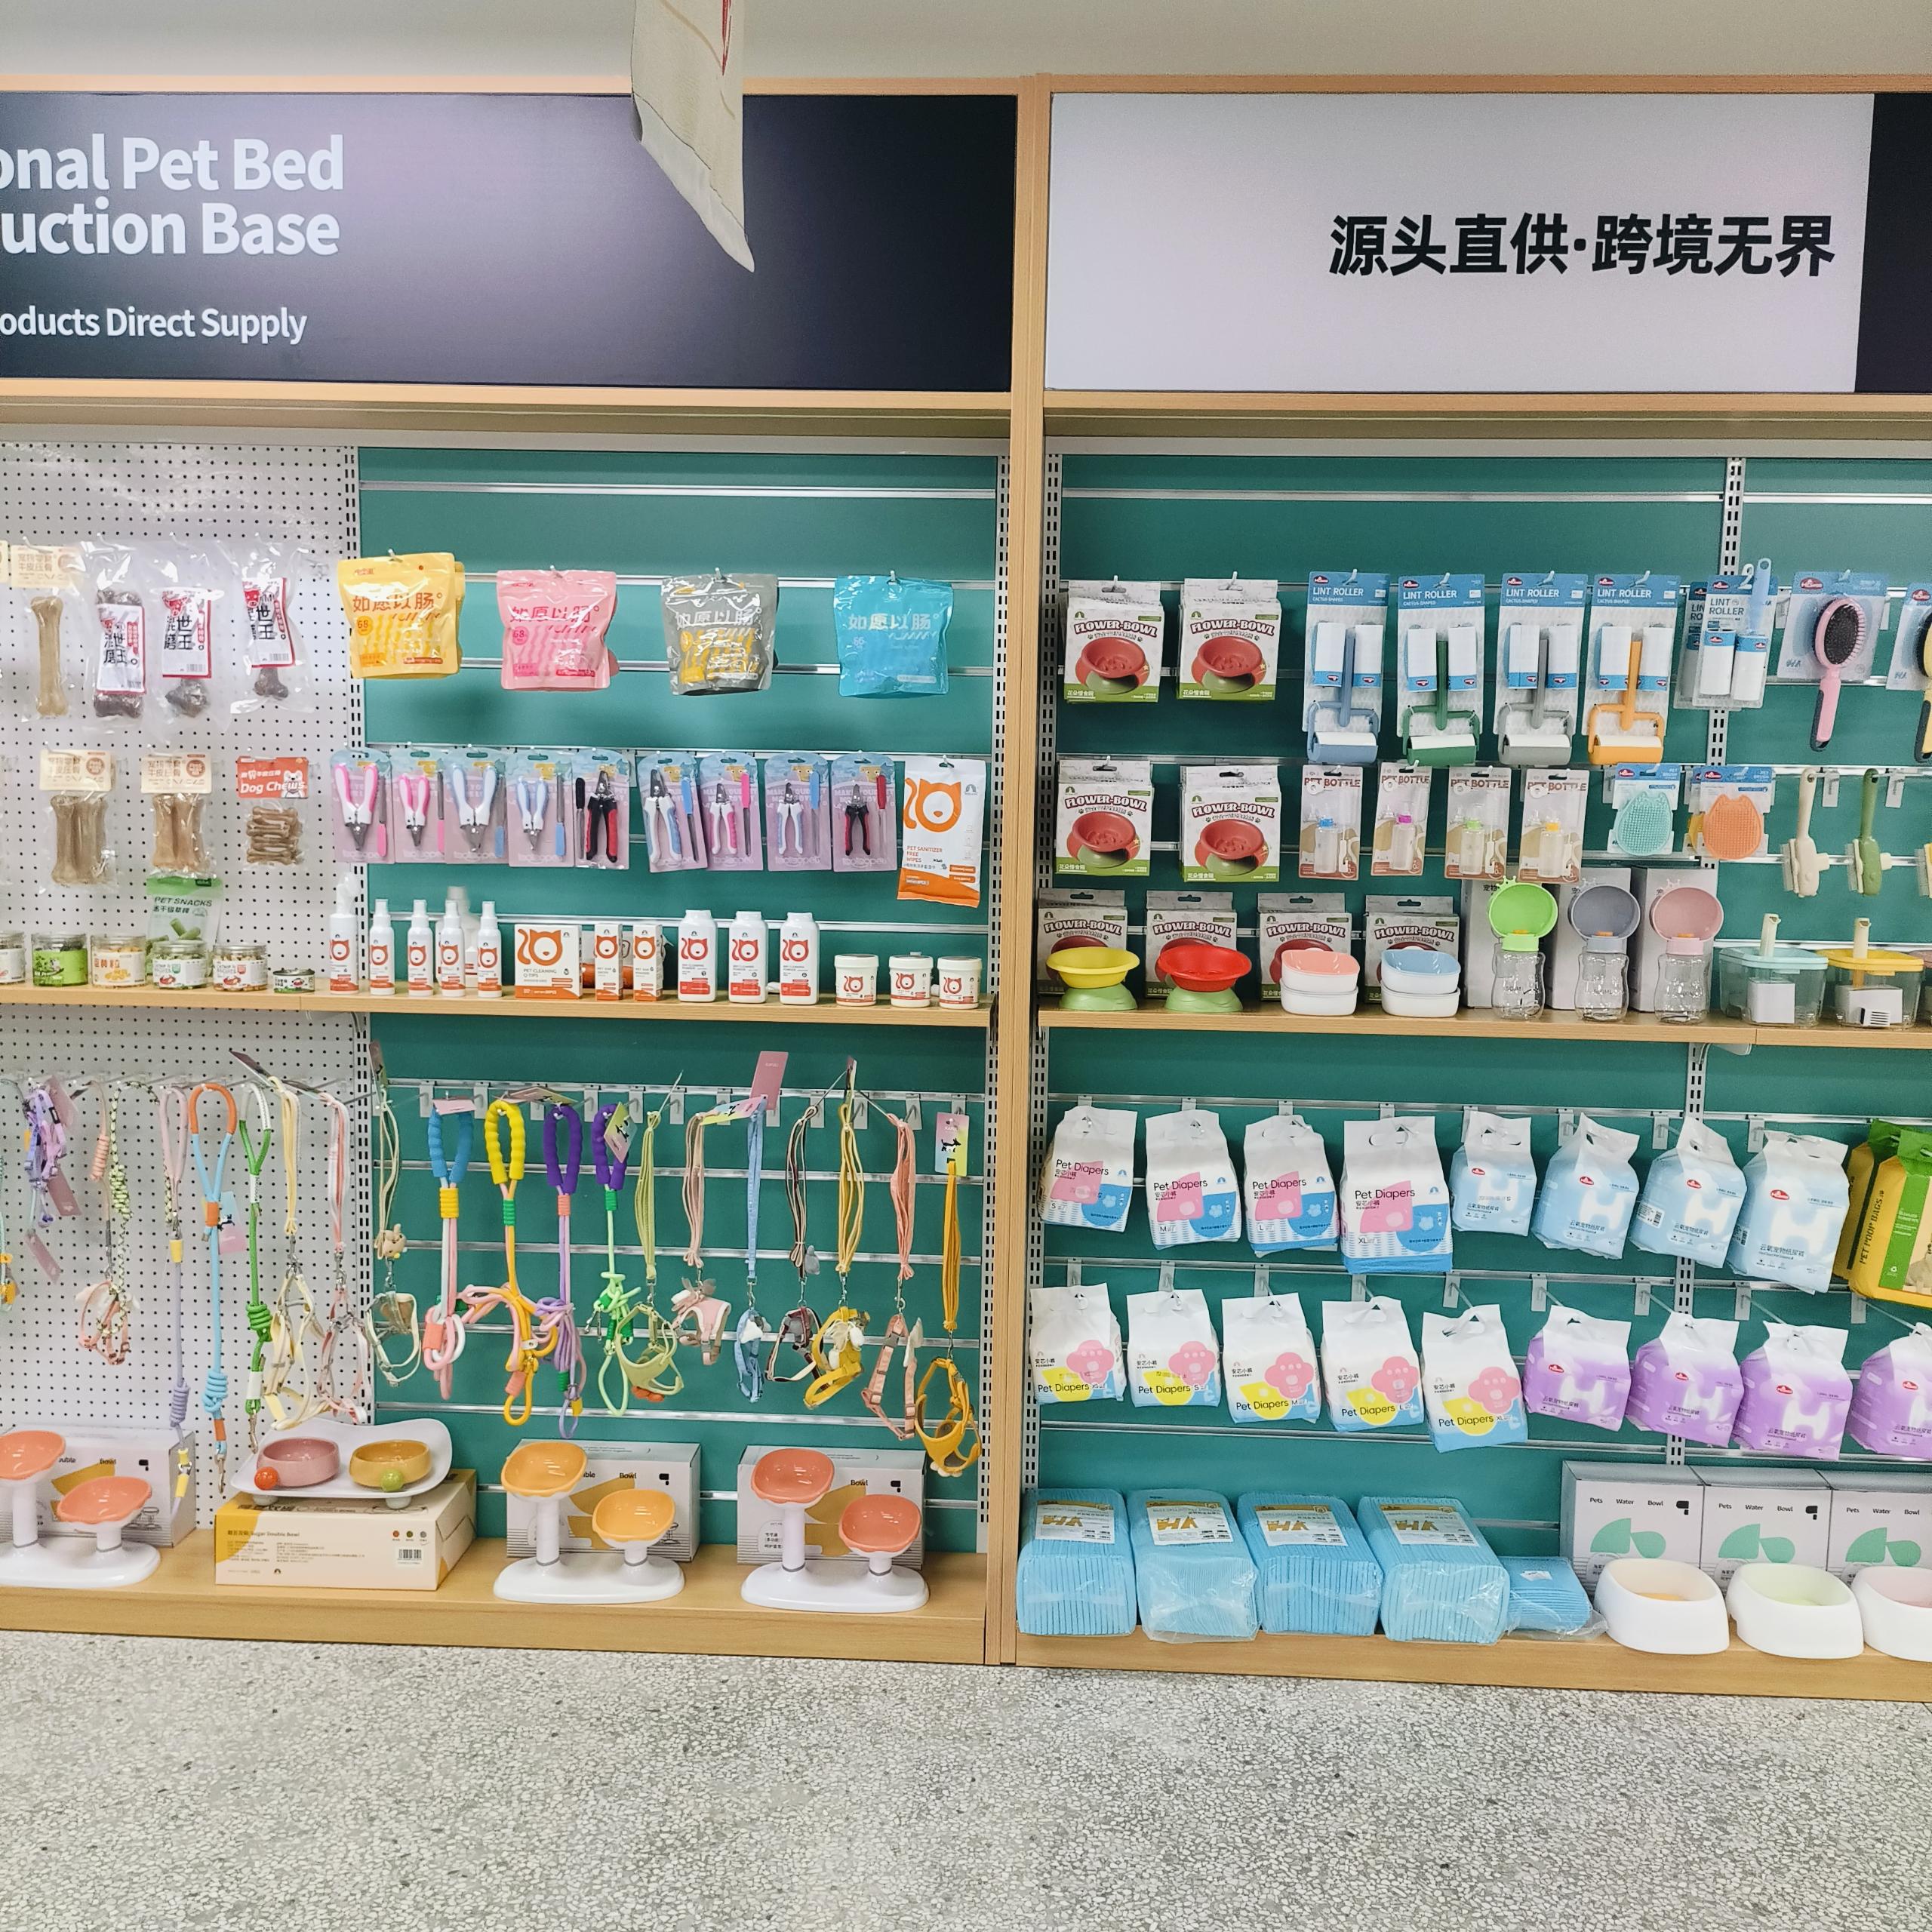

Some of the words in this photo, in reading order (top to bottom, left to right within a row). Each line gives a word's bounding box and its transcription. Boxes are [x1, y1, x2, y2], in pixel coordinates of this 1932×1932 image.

[123, 137, 219, 191] Pet
[233, 134, 344, 191] Bed
[1, 196, 186, 254] uction
[202, 202, 340, 255] Base
[1328, 212, 1835, 278] 源头直供·跨境无界
[0, 305, 100, 337] oducts
[106, 306, 195, 337] Direct
[202, 307, 307, 345] Supply
[1312, 587, 1331, 595] LINT
[1333, 587, 1364, 597] ROLLER
[1403, 591, 1422, 599] LINT
[1424, 590, 1457, 599] ROLLER
[1506, 589, 1524, 597] LINT
[1527, 589, 1559, 597] ROLLER
[1619, 589, 1651, 598] ROLLER
[1691, 604, 1705, 612] LIN
[1709, 607, 1744, 615] ROLLER
[1074, 619, 1158, 638] FLOWER-BOWL
[1190, 619, 1275, 636] FLOWER-BOWL
[239, 783, 264, 795] Dog
[266, 781, 305, 792] Chews
[1065, 794, 1147, 812] FLOWER-BOWL
[1192, 802, 1276, 818] FLOWER-BOWL
[174, 897, 213, 906] SNACKS
[1044, 919, 1122, 936] FLOWER-BOWL
[1152, 921, 1232, 937] FLOWER-BOWL
[1266, 921, 1347, 938] FLOWER-BOWL
[1374, 925, 1455, 942] FLOWER-BOWL
[1057, 1159, 1072, 1169] Pet
[1074, 1161, 1109, 1176] Diapers
[1153, 1183, 1170, 1191] Pet
[1172, 1179, 1208, 1190] Diapers
[1253, 1181, 1268, 1190] Pet
[1271, 1178, 1307, 1189] Diapers
[1355, 1190, 1371, 1199] Pet
[1375, 1189, 1415, 1200] Diapers
[1870, 1198, 1883, 1221] BAGS
[1865, 1222, 1876, 1245] POOP
[1859, 1247, 1869, 1265] PET
[1038, 1384, 1053, 1393] Pet
[1055, 1383, 1089, 1393] Diapers
[1138, 1386, 1152, 1395] Pet
[1156, 1385, 1190, 1394] Diapers
[1235, 1401, 1251, 1411] Pet
[1253, 1399, 1289, 1410] Diapers
[1341, 1408, 1358, 1417] Pet
[1359, 1405, 1395, 1416] Diapers
[1438, 1418, 1454, 1427] Pet
[1457, 1414, 1494, 1426] Diapers
